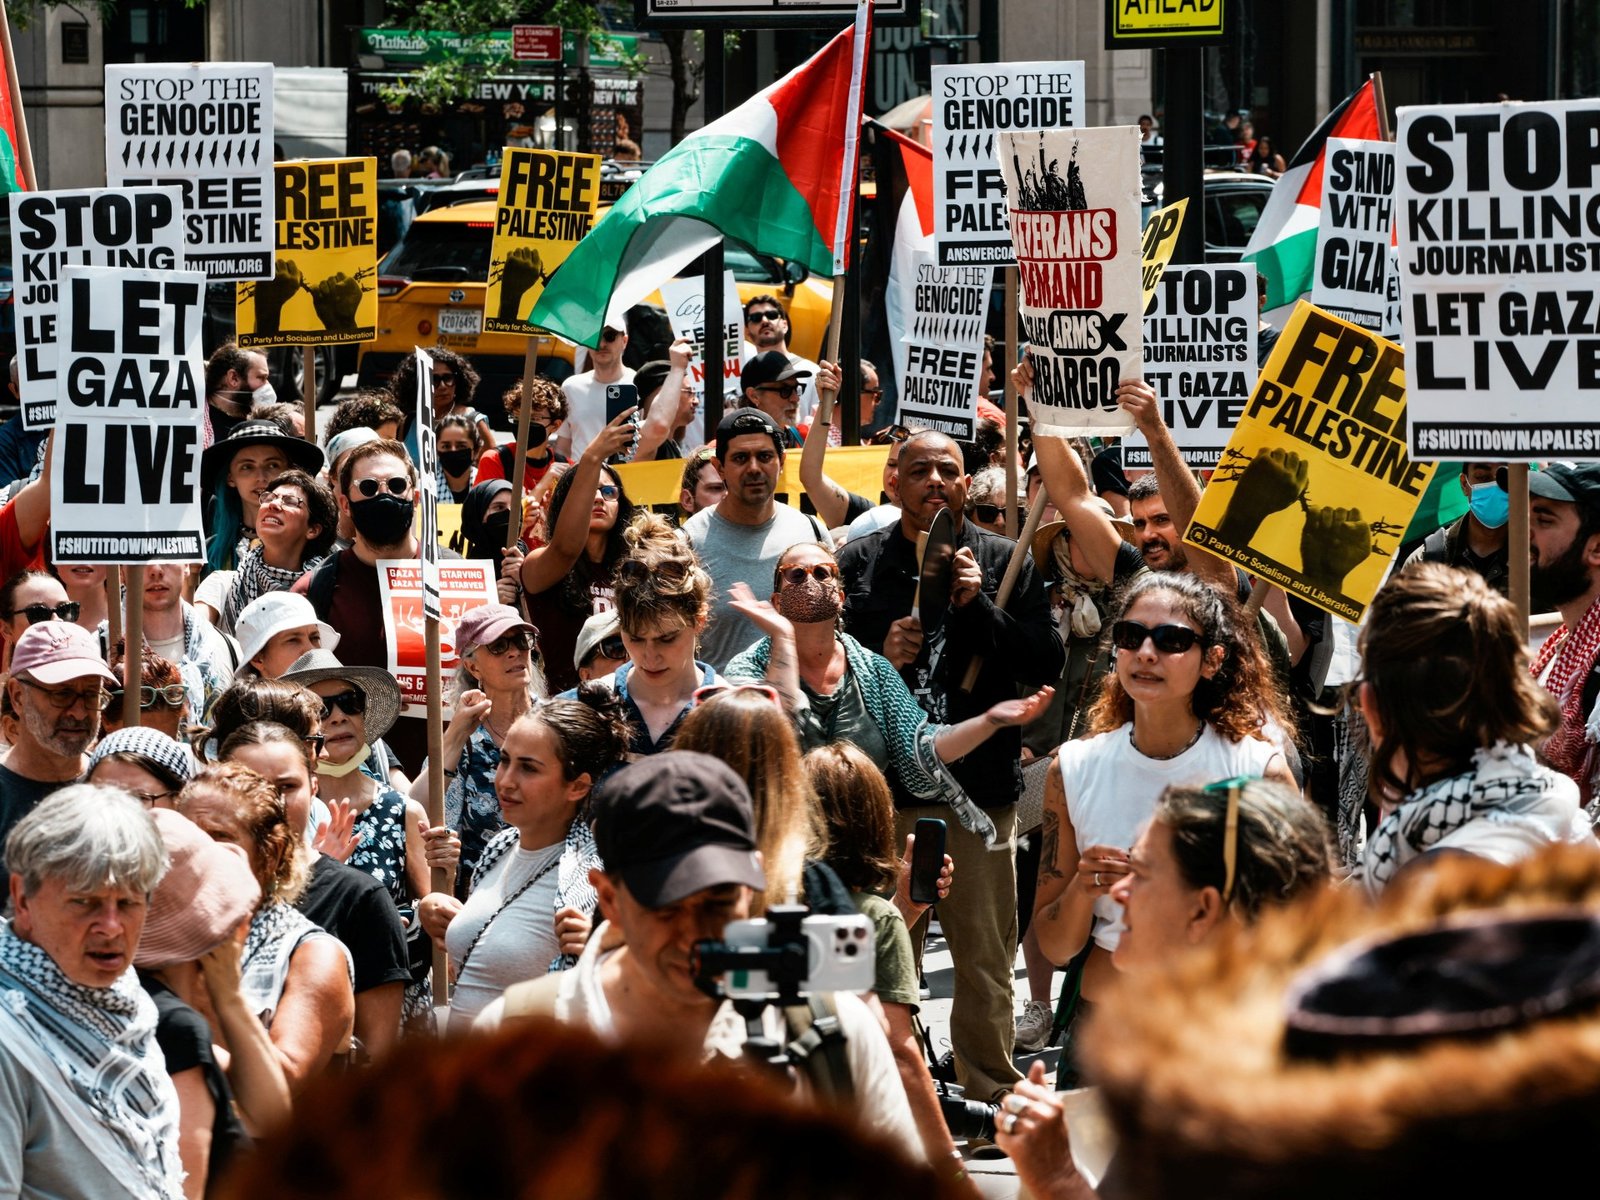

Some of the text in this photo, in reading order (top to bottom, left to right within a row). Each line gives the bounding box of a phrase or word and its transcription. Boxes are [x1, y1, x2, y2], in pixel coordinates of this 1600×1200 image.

[525, 29, 554, 37] STANDING
[120, 77, 261, 101] STOP THE
[593, 90, 614, 104] NEW
[943, 73, 1072, 98] STOP THE
[120, 102, 262, 135] GENOCIDE
[943, 97, 1073, 131] GENOCIDE
[1406, 110, 1600, 195] STOP
[274, 161, 367, 221] REE
[505, 151, 594, 212] FREE
[945, 169, 1008, 199] FR
[18, 193, 173, 251] STOP
[184, 213, 262, 244] STINE
[274, 218, 374, 250] LESTINE
[497, 207, 593, 242] PALESTINE
[1142, 207, 1180, 261] OP
[917, 263, 987, 287] STOP THE
[1409, 242, 1600, 276] JOURNALIST
[915, 284, 984, 317] GENOCIDE
[1020, 261, 1103, 309] DEMAND
[1143, 269, 1247, 316] TOP
[71, 278, 199, 356] LET
[495, 322, 510, 331] Party
[511, 323, 521, 331] for
[1142, 317, 1248, 343] ILLING
[1412, 292, 1486, 337] LET
[1498, 290, 1600, 337] GAZ
[253, 336, 273, 345] Party
[286, 333, 322, 343] Socialism
[322, 333, 337, 341] and
[338, 330, 374, 341] Liberation
[1053, 315, 1102, 350] ARMS
[906, 345, 977, 380] FREE
[1142, 344, 1248, 363] OURNALISTS
[67, 356, 198, 409] GAZA
[690, 358, 742, 383] NW
[1178, 371, 1249, 398] GAZA
[1277, 311, 1407, 445] FRE
[903, 375, 973, 410] PALESTINE
[1247, 379, 1432, 498] PALESTINE
[1418, 428, 1600, 451] #SHUTITDOWN4PALEST
[63, 423, 197, 505] LIVE
[58, 536, 199, 555] #SHUTITDOWN4PALESTINE
[389, 568, 414, 578] GAZA
[440, 568, 483, 579] STARVING
[391, 579, 414, 588] GAZA
[450, 580, 484, 589] STARVED
[1208, 536, 1361, 620] Party for Socialism and Liberation
